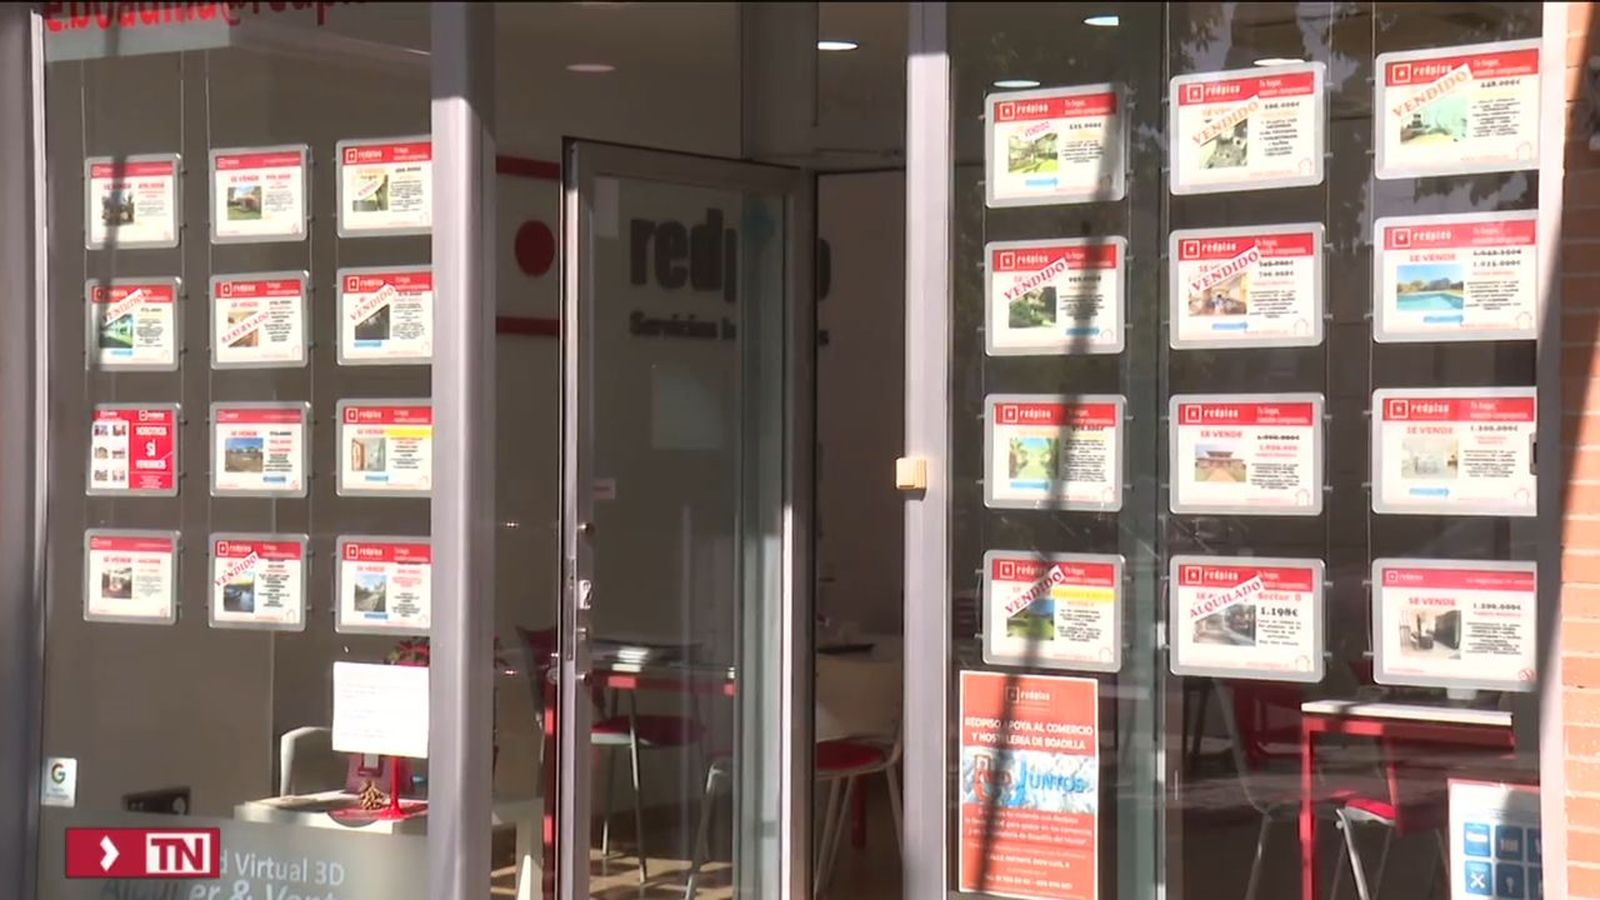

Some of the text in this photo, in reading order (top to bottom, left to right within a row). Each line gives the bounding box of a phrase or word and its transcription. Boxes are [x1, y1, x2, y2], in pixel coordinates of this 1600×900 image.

[1205, 85, 1240, 96] redpiso
[1392, 71, 1467, 118] VENDIDO
[1192, 101, 1259, 144] VENDIDO
[1201, 242, 1236, 252] redpiso
[1017, 255, 1048, 266] redpiso
[1423, 254, 1456, 262] VENDE
[1191, 250, 1259, 292] VENDIDO
[1004, 262, 1065, 301] VENDIDO
[350, 287, 394, 320] VENDIDO
[1020, 408, 1051, 419] redpiso
[1203, 408, 1239, 419] redpiso
[1411, 402, 1449, 414] redpiso
[1213, 430, 1243, 438] VENDE
[1407, 426, 1453, 434] SE VENDE
[215, 554, 258, 586] VENDIDO
[1204, 570, 1239, 581] redpiso
[1005, 571, 1062, 614] VENDIDO
[1257, 592, 1289, 601] Sector
[1189, 580, 1261, 618] ALQUILADO
[1422, 598, 1456, 606] VENDE
[1260, 607, 1299, 617] 1.198€
[1034, 722, 1045, 733] AL
[1046, 722, 1093, 736] COMERCIO
[1031, 736, 1044, 747] DE
[1045, 737, 1086, 750] BOADILLA
[235, 852, 307, 882] Virtual
[315, 862, 345, 886] 3D
